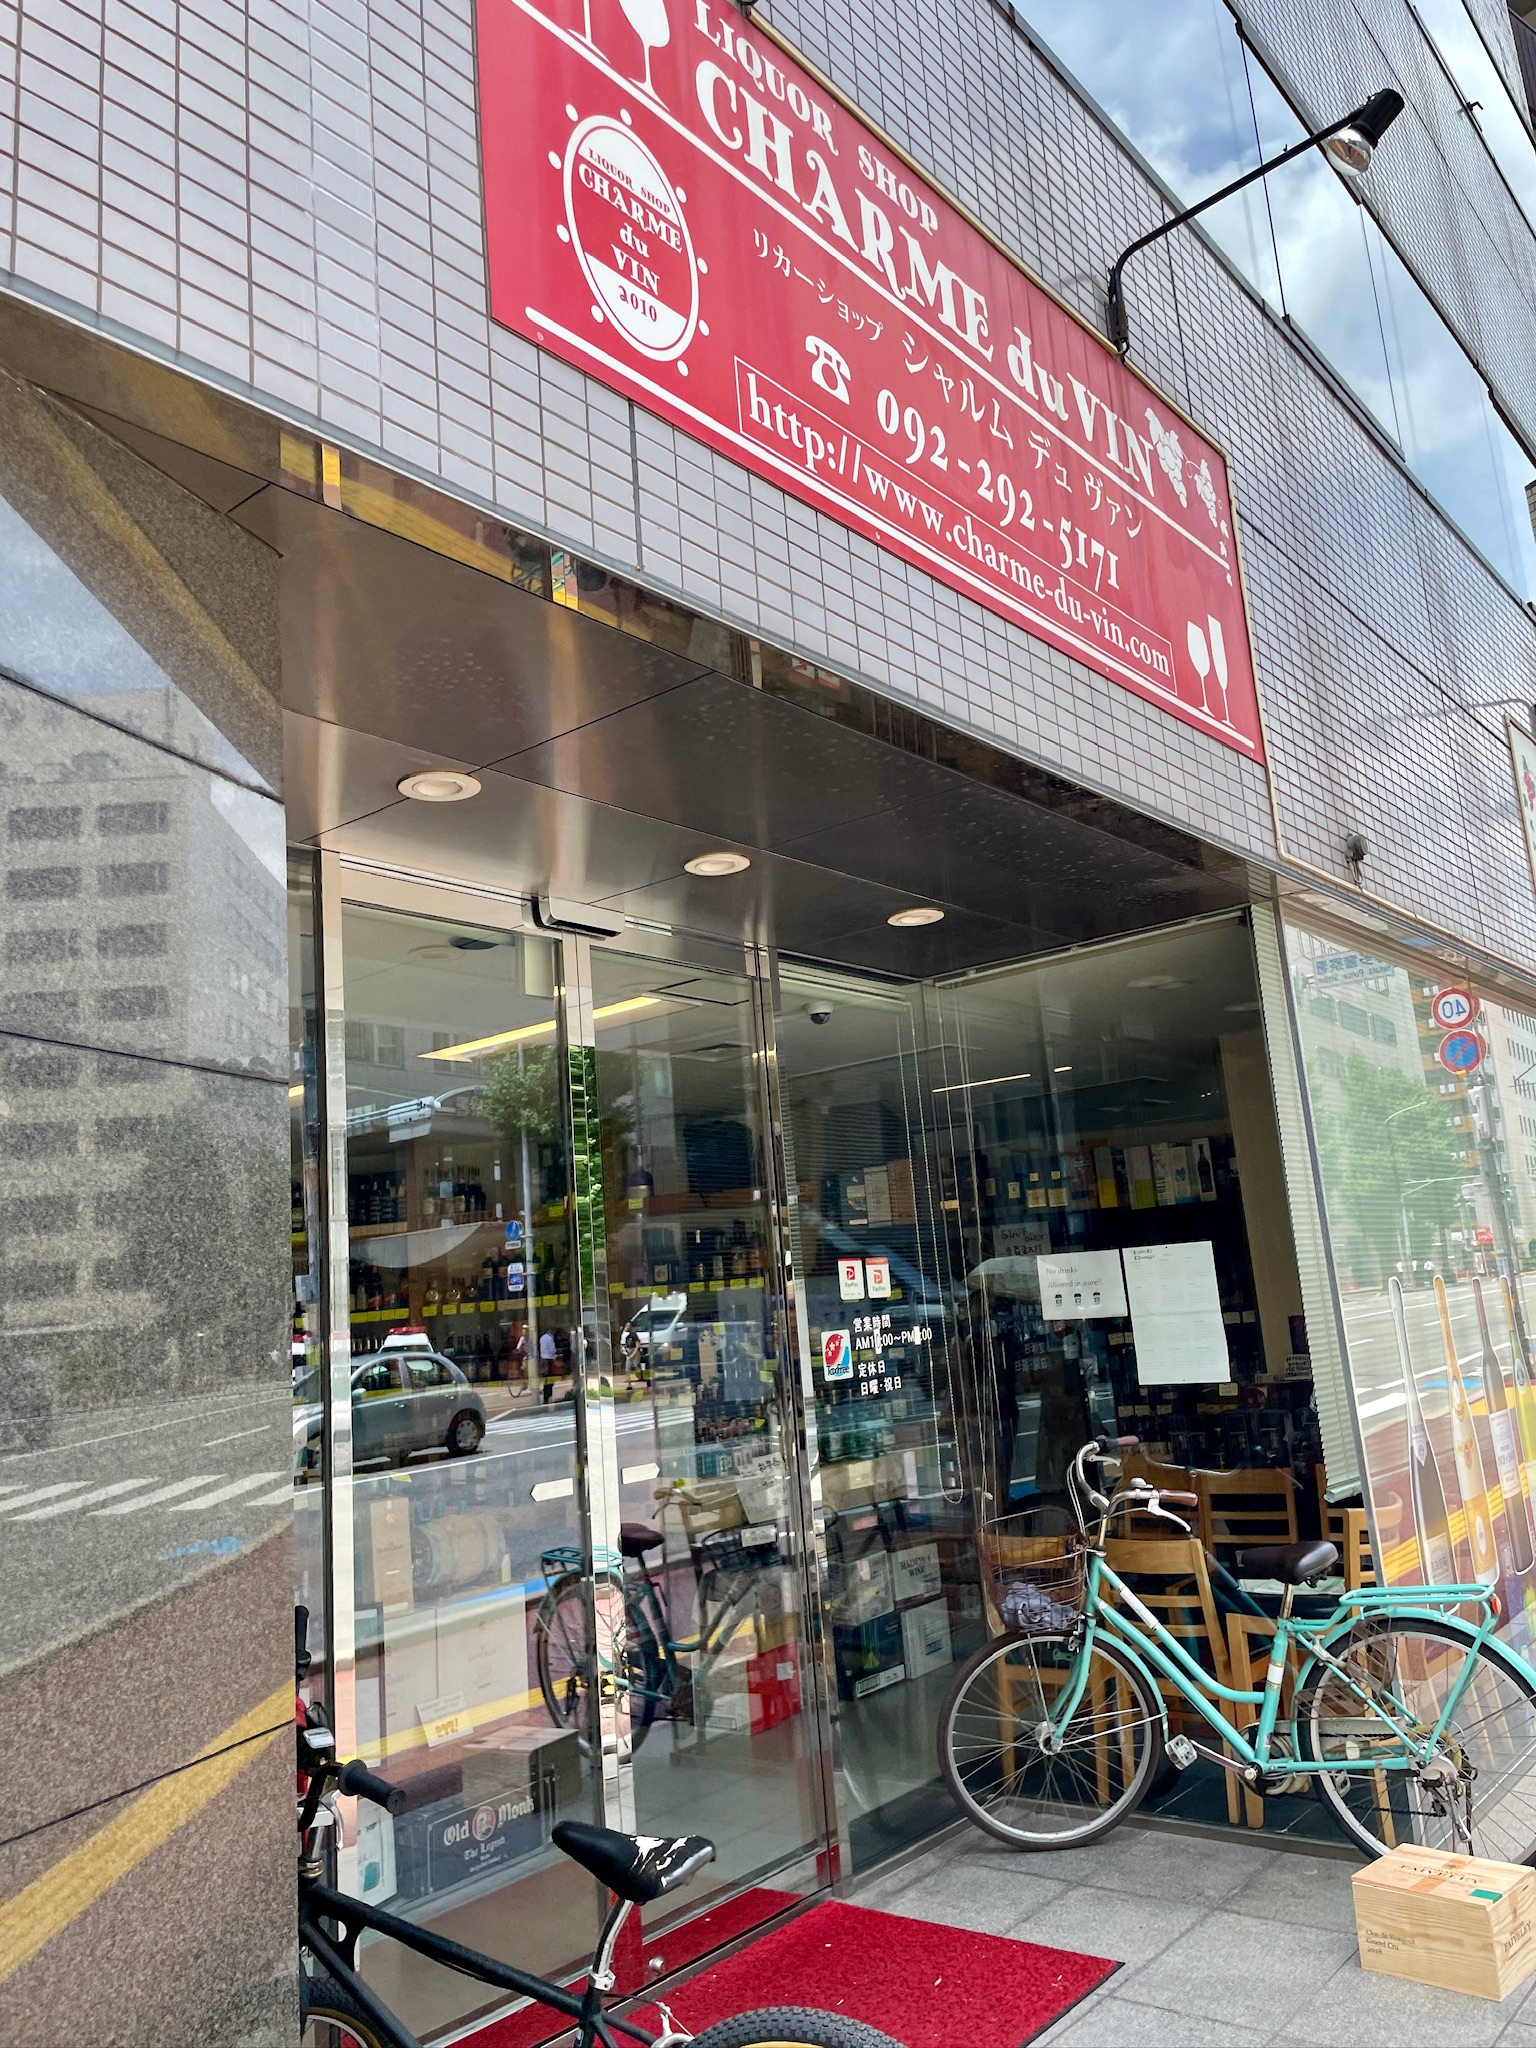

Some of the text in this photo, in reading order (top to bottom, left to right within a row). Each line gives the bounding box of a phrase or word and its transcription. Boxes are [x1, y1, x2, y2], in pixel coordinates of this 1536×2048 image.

[693, 3, 939, 236] LIQUOR SHOP
[588, 147, 671, 215] LIQUOR SHOP
[578, 163, 684, 253] CHARME
[695, 60, 995, 363] CHARME
[619, 223, 650, 259] du
[610, 243, 661, 296] VIN
[617, 284, 658, 324] 2010
[753, 228, 1143, 539] リカーショップ シャルム デュ ヴァン
[748, 372, 1171, 677] http://www.charme-du-vin.com
[1048, 1280, 1074, 1289] Allowed
[1057, 1266, 1077, 1274] drinks
[854, 1314, 890, 1333] 営業時間
[858, 1360, 885, 1377] 定休日
[860, 1376, 902, 1397] 日曜・祝日
[443, 1795, 535, 1846] Old Monk
[1366, 1937, 1399, 1951] Grand Cru
